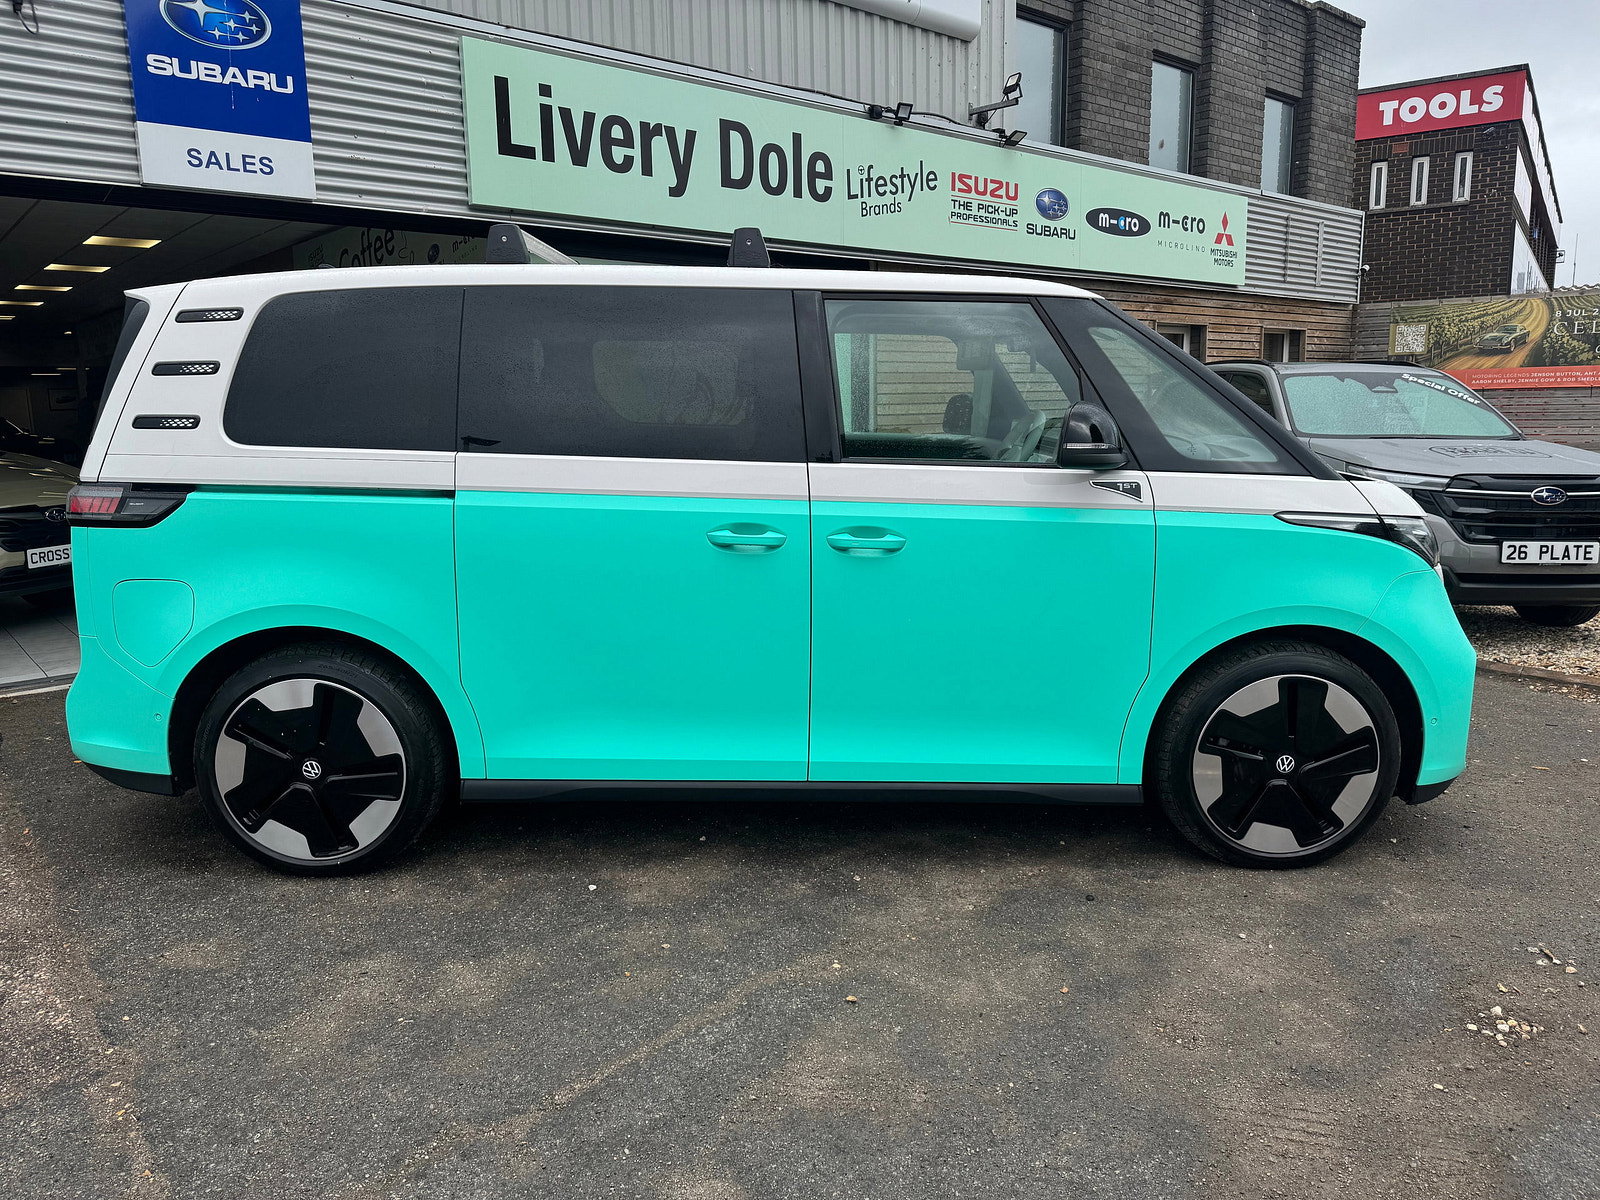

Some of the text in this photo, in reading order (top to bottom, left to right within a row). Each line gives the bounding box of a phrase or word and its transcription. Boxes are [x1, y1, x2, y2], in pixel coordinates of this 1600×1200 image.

[146, 53, 294, 94] SUBARU
[1379, 85, 1504, 126] TOOLS
[494, 75, 834, 202] Livery Dole
[186, 148, 275, 176] SALES
[846, 160, 938, 202] Lifestyle
[950, 171, 1019, 201] ISUZU
[861, 196, 902, 217] Brands
[951, 199, 1018, 217] THE PICK-UP
[950, 211, 1018, 228] PROFESSIONALS
[1026, 222, 1076, 240] SUBARU
[1157, 240, 1206, 253] MICROLINO
[1210, 247, 1238, 259] MITSUBISHI
[1213, 257, 1235, 268] MOTORS
[1566, 309, 1588, 317] JUL
[1401, 373, 1481, 404] Special Offer
[1117, 483, 1138, 491] 1ST
[30, 548, 71, 564] CROSS
[1506, 544, 1594, 561] 26 PLATE
